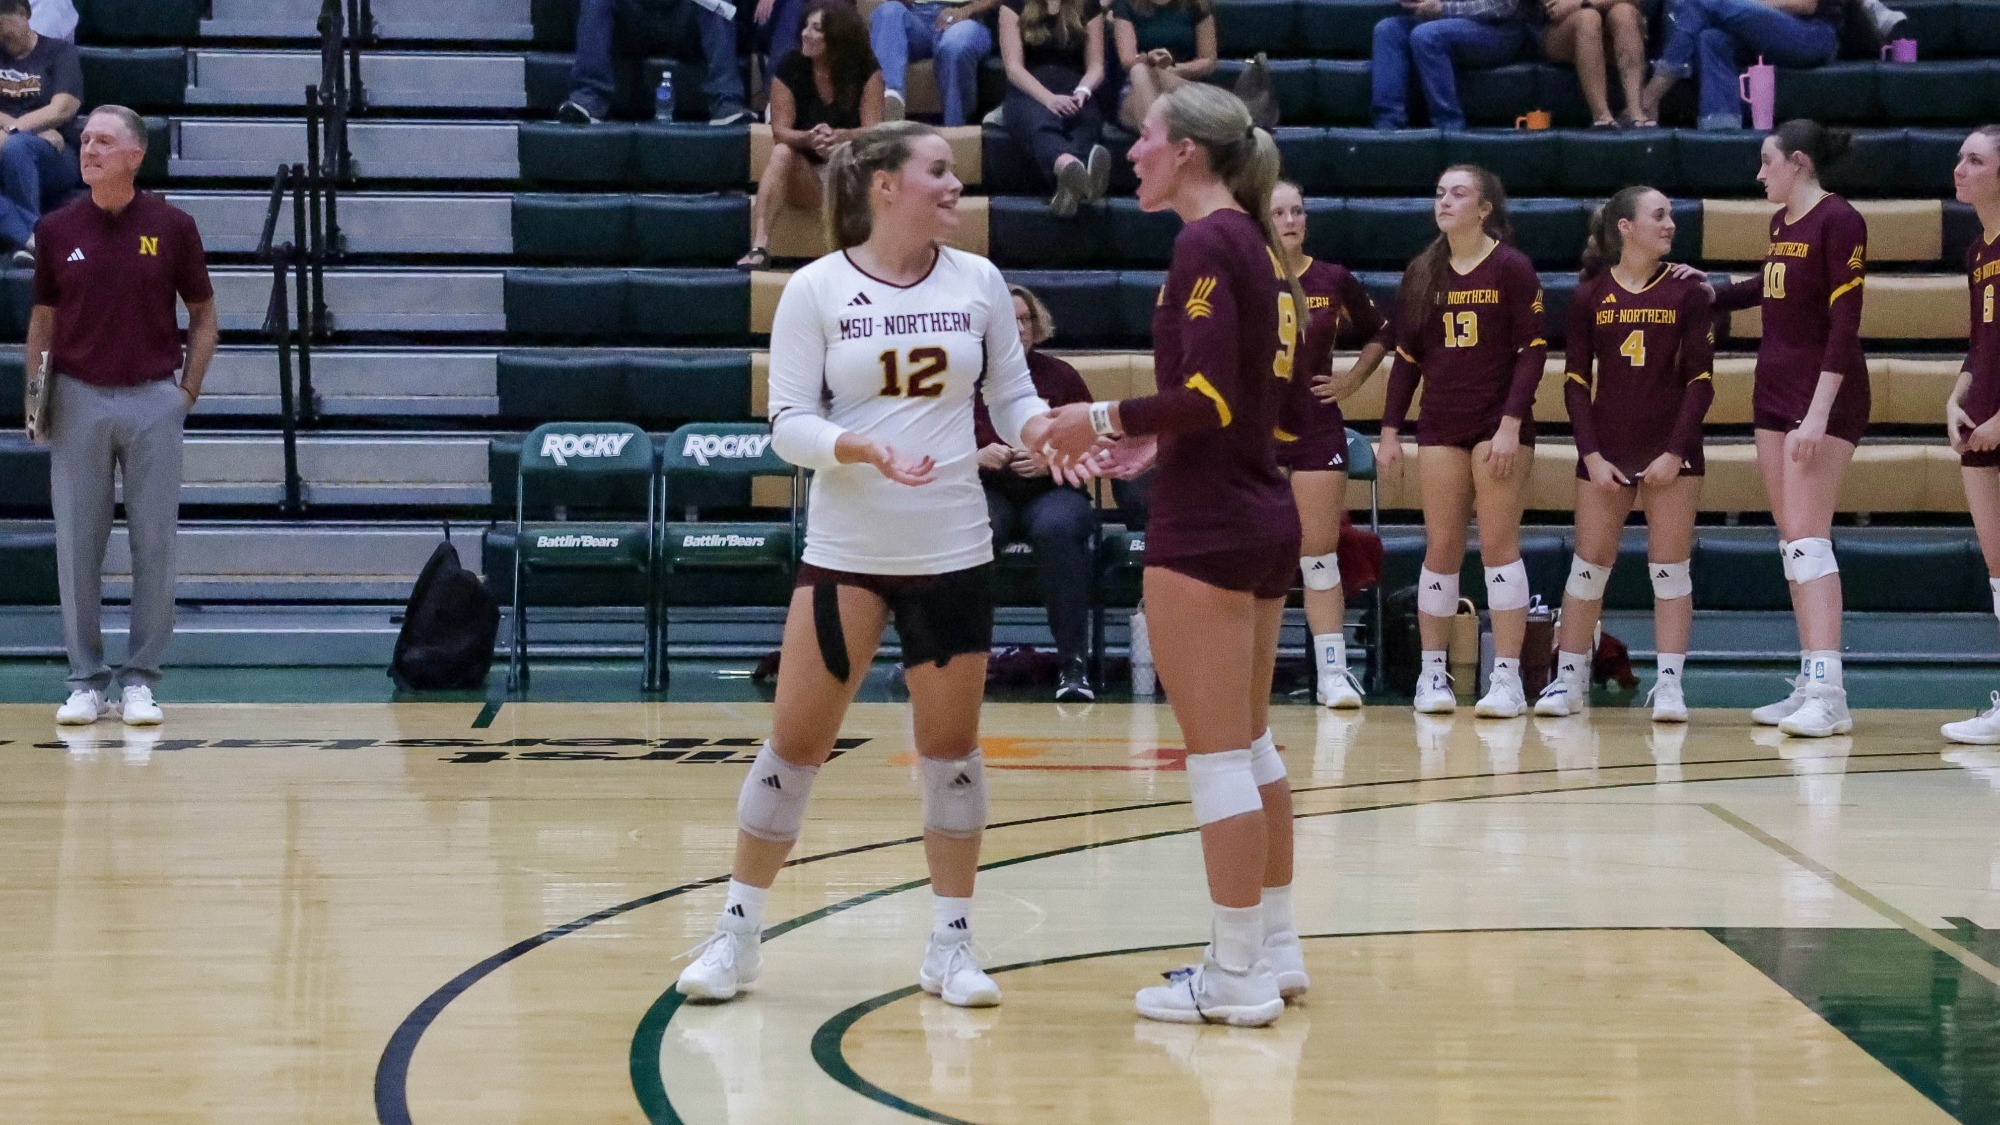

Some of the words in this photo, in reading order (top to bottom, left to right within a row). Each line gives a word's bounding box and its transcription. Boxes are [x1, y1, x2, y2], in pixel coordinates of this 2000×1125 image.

[139, 235, 159, 256] N
[1763, 261, 1786, 299] 10
[1596, 308, 1677, 325] MSU-NORTHERN
[1983, 284, 1995, 323] 6
[840, 312, 971, 340] MSU-NORTHERN
[1272, 290, 1298, 383] 9
[1442, 311, 1478, 348] 13
[1620, 329, 1646, 367] 4
[878, 345, 948, 398] 12
[540, 432, 635, 467] ROCKY
[682, 433, 772, 467] ROCKY
